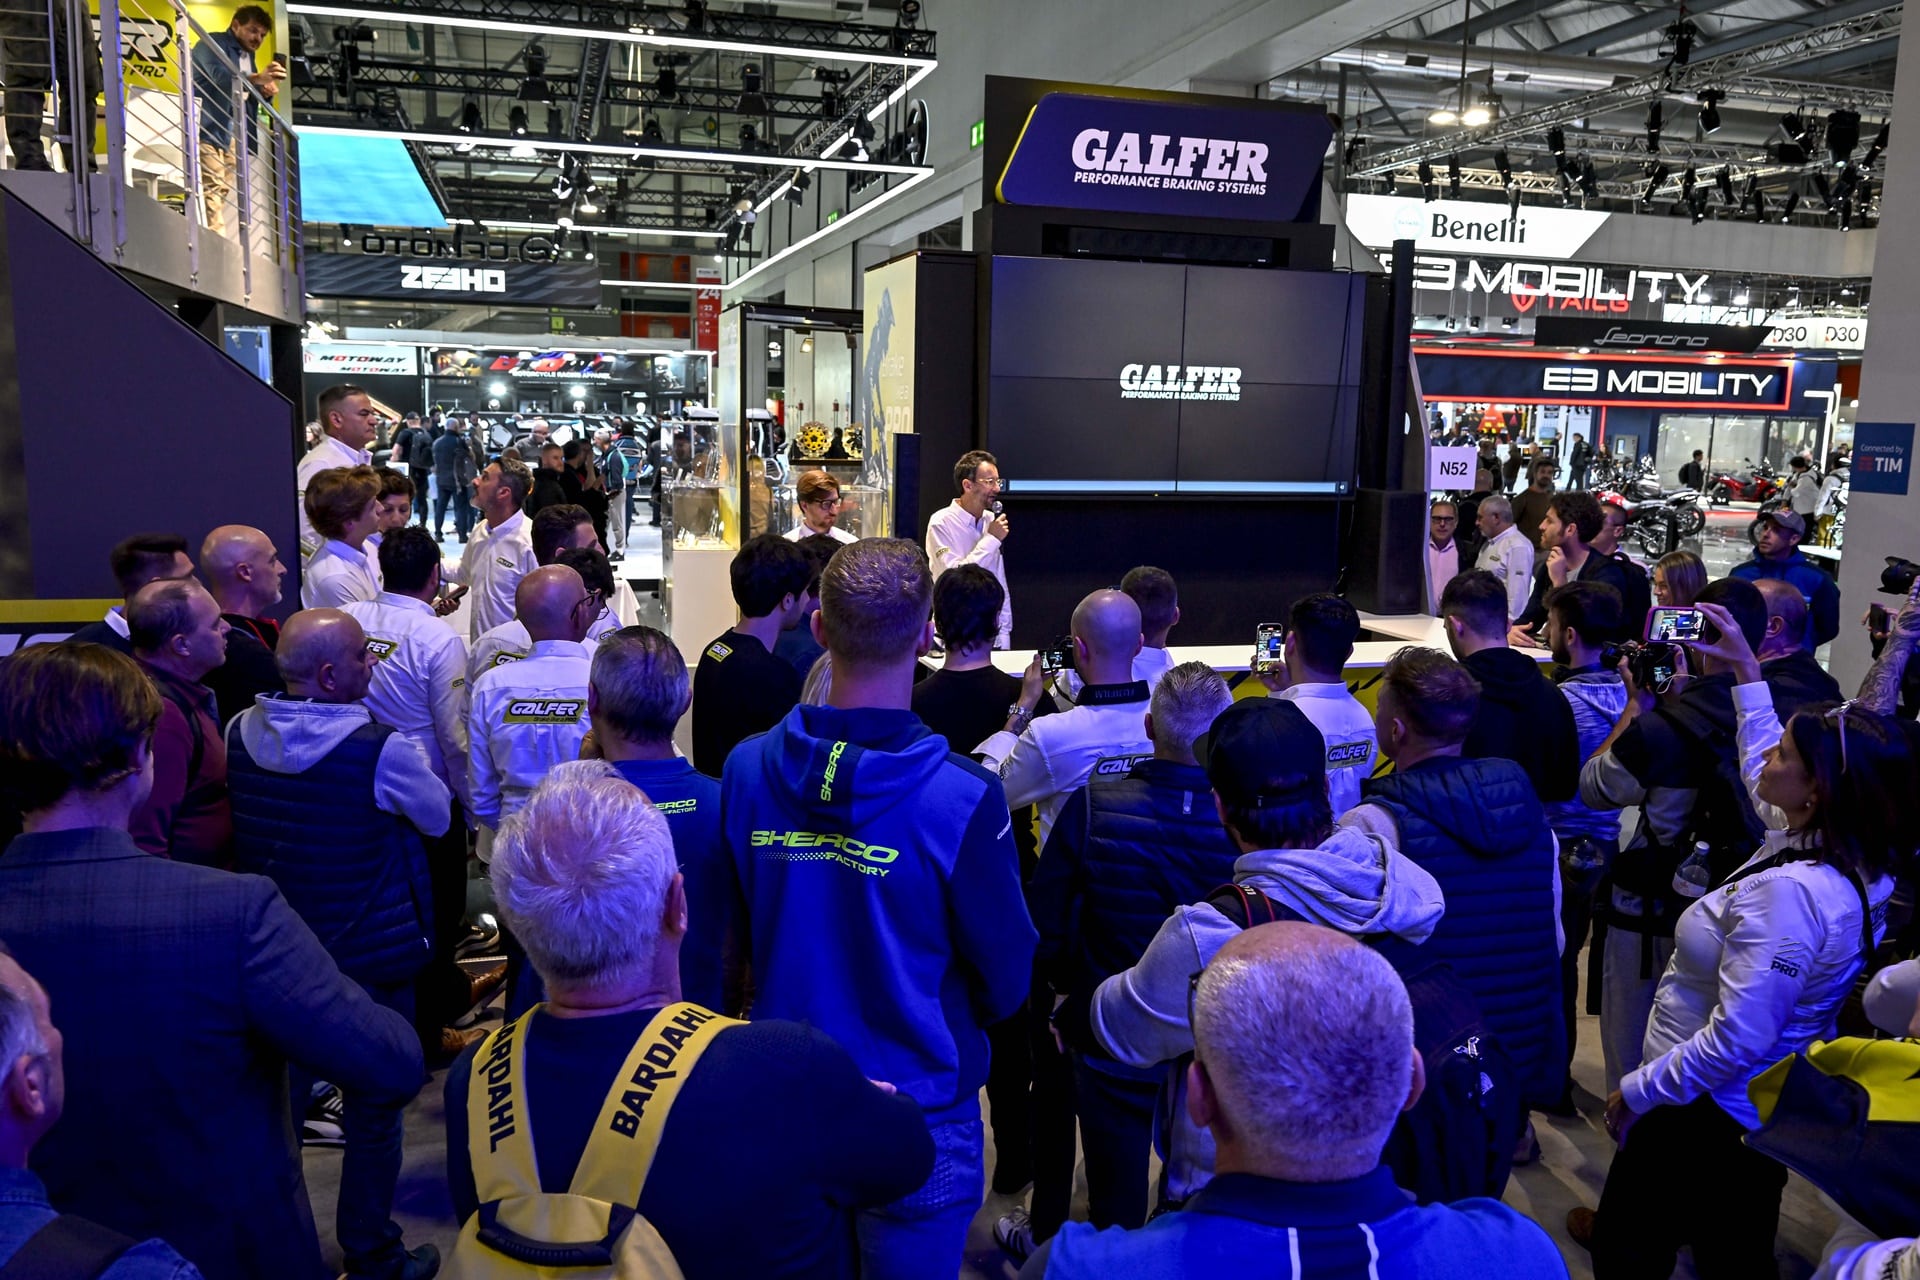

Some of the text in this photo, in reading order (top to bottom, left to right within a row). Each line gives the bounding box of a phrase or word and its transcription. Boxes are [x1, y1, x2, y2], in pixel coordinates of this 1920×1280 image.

[130, 64, 166, 77] PRO
[1071, 127, 1270, 183] GALFER
[1074, 171, 1267, 196] PERFORMANCE BRAKING SYSTEMS
[1431, 212, 1526, 243] Benelli
[1468, 259, 1710, 305] MOBILITY
[320, 355, 407, 363] MOTOWAY
[1119, 363, 1242, 393] GALFER
[1606, 369, 1774, 396] MOBILITY
[1121, 390, 1241, 401] PERFORMANCE BRAKING SYSTEMS
[1860, 443, 1904, 454] Connected by
[1440, 461, 1469, 477] N52
[1875, 457, 1903, 473] TIM
[510, 702, 579, 716] GALFER
[1329, 744, 1368, 762] GALFER
[653, 799, 697, 810] ERCO
[668, 807, 697, 815] FACTORY
[751, 831, 900, 863] SHERCO
[825, 852, 889, 877] FACTORY
[1770, 959, 1799, 978] PRO
[609, 1007, 717, 1140] BARDAHL
